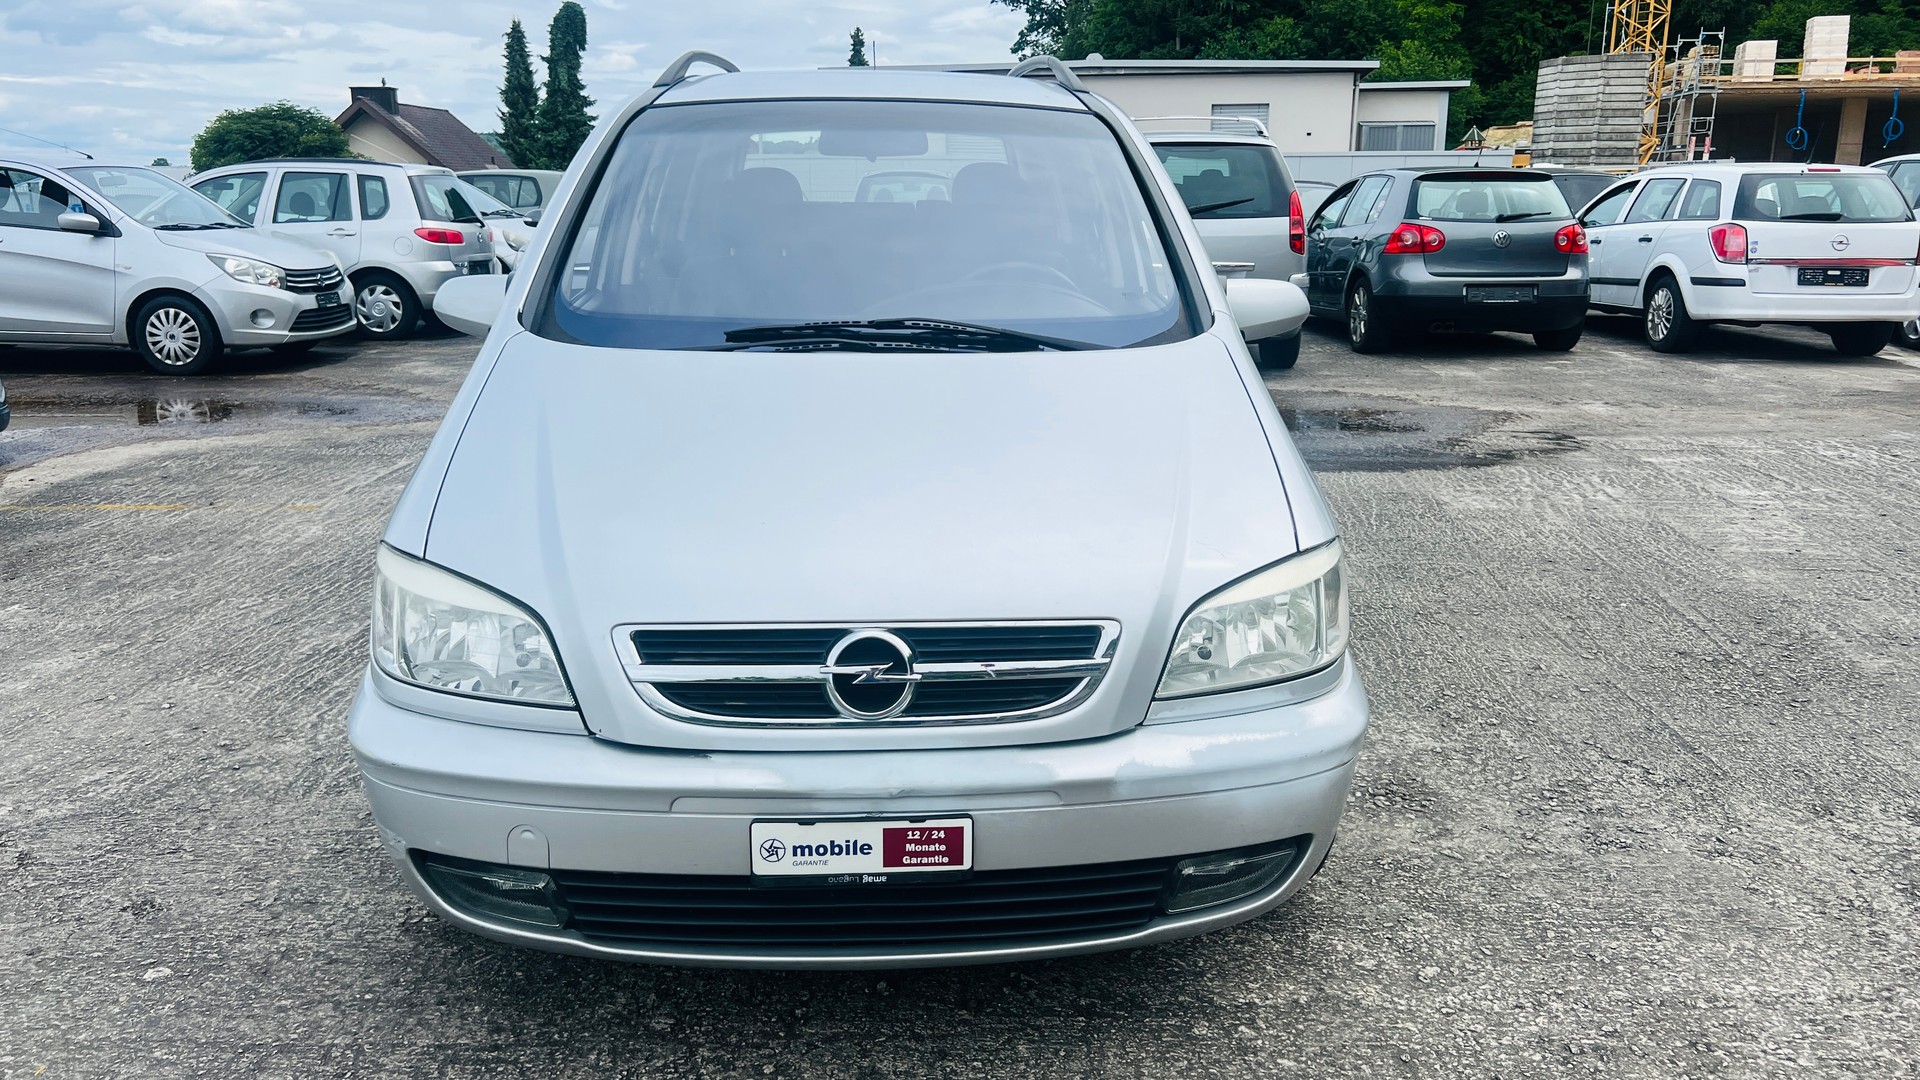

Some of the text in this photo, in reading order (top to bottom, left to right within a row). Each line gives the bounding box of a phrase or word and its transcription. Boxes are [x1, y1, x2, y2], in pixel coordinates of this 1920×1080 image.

[907, 830, 946, 841] 12 / 24
[792, 839, 873, 857] mobile
[905, 843, 947, 852] Monate
[792, 859, 829, 867] GARANTIE
[902, 855, 949, 864] Garantie
[827, 874, 888, 883] amag Lugano
